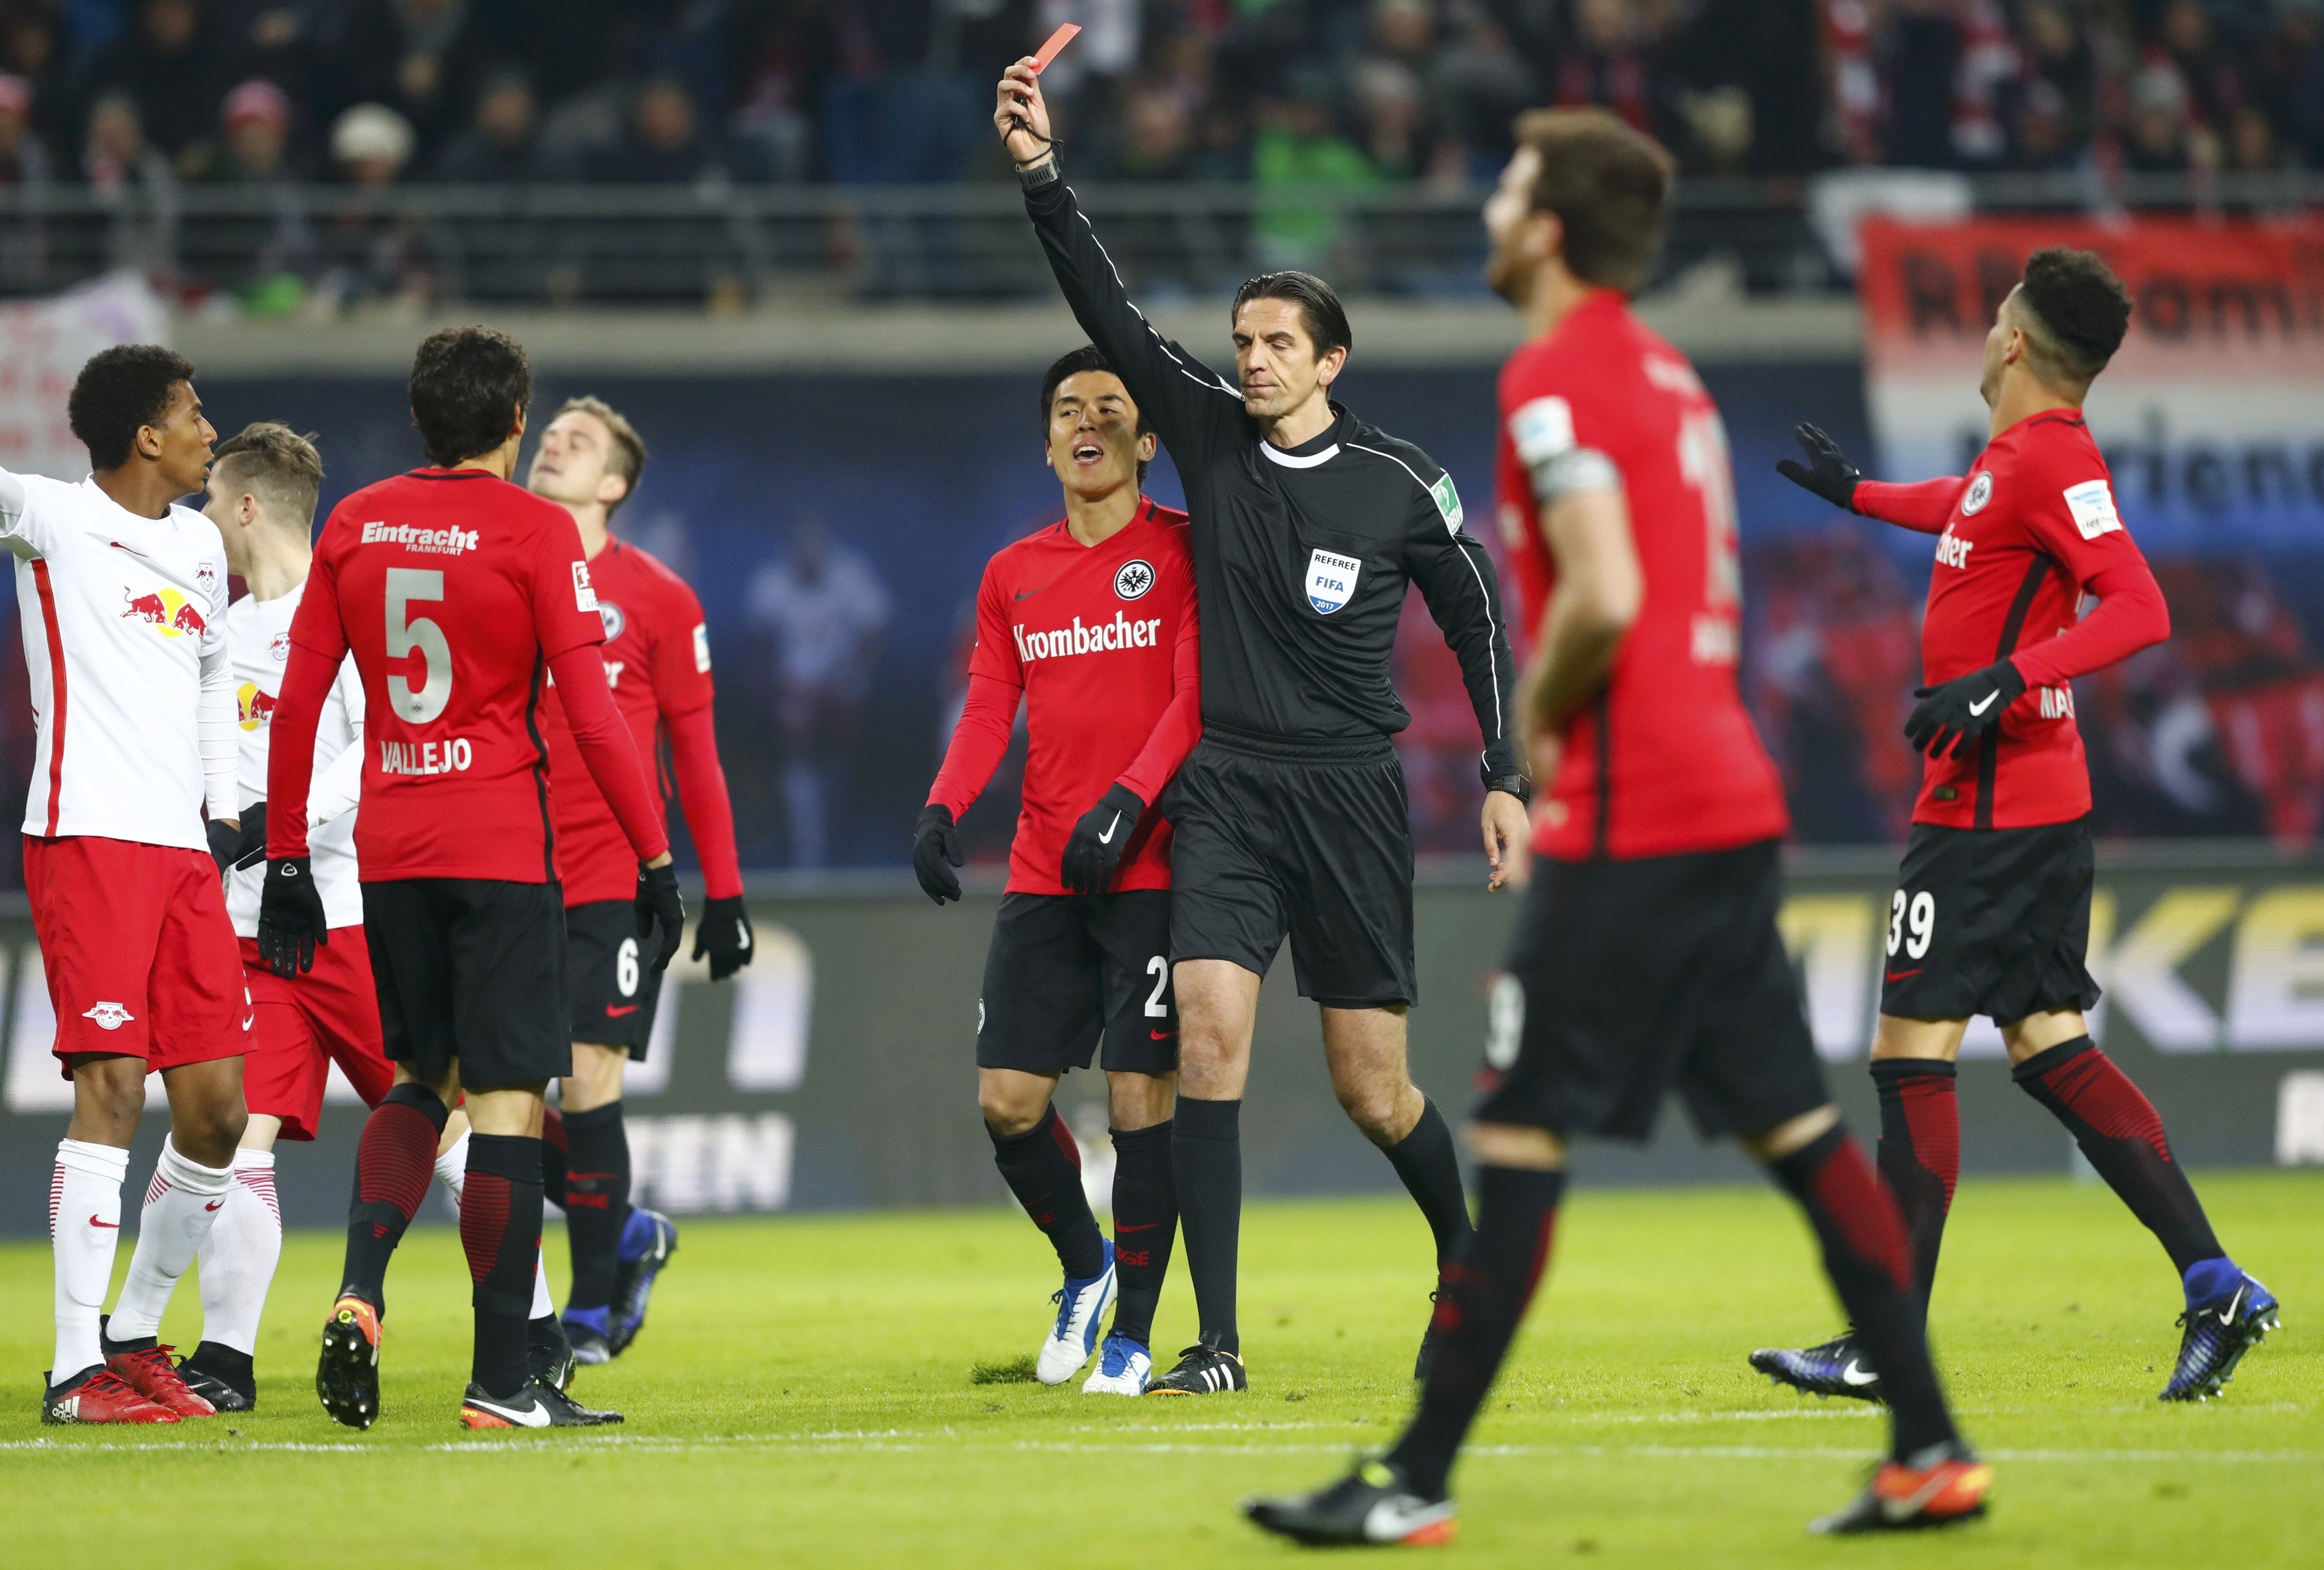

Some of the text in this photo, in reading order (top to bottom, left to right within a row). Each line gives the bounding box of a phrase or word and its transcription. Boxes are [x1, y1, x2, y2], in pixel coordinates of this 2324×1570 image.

[361, 521, 479, 551] Eintracht
[406, 544, 463, 557] FRANKFURT
[1315, 554, 1357, 571] REFEREE
[1315, 576, 1344, 592] FIFA
[1317, 600, 1334, 610] 2017
[385, 567, 453, 725] 5
[1013, 610, 1161, 663] Krombacher
[381, 738, 472, 776] VALLEJO
[1886, 889, 1935, 960] 39
[617, 937, 639, 997] 6
[1145, 955, 1168, 1017] 2
